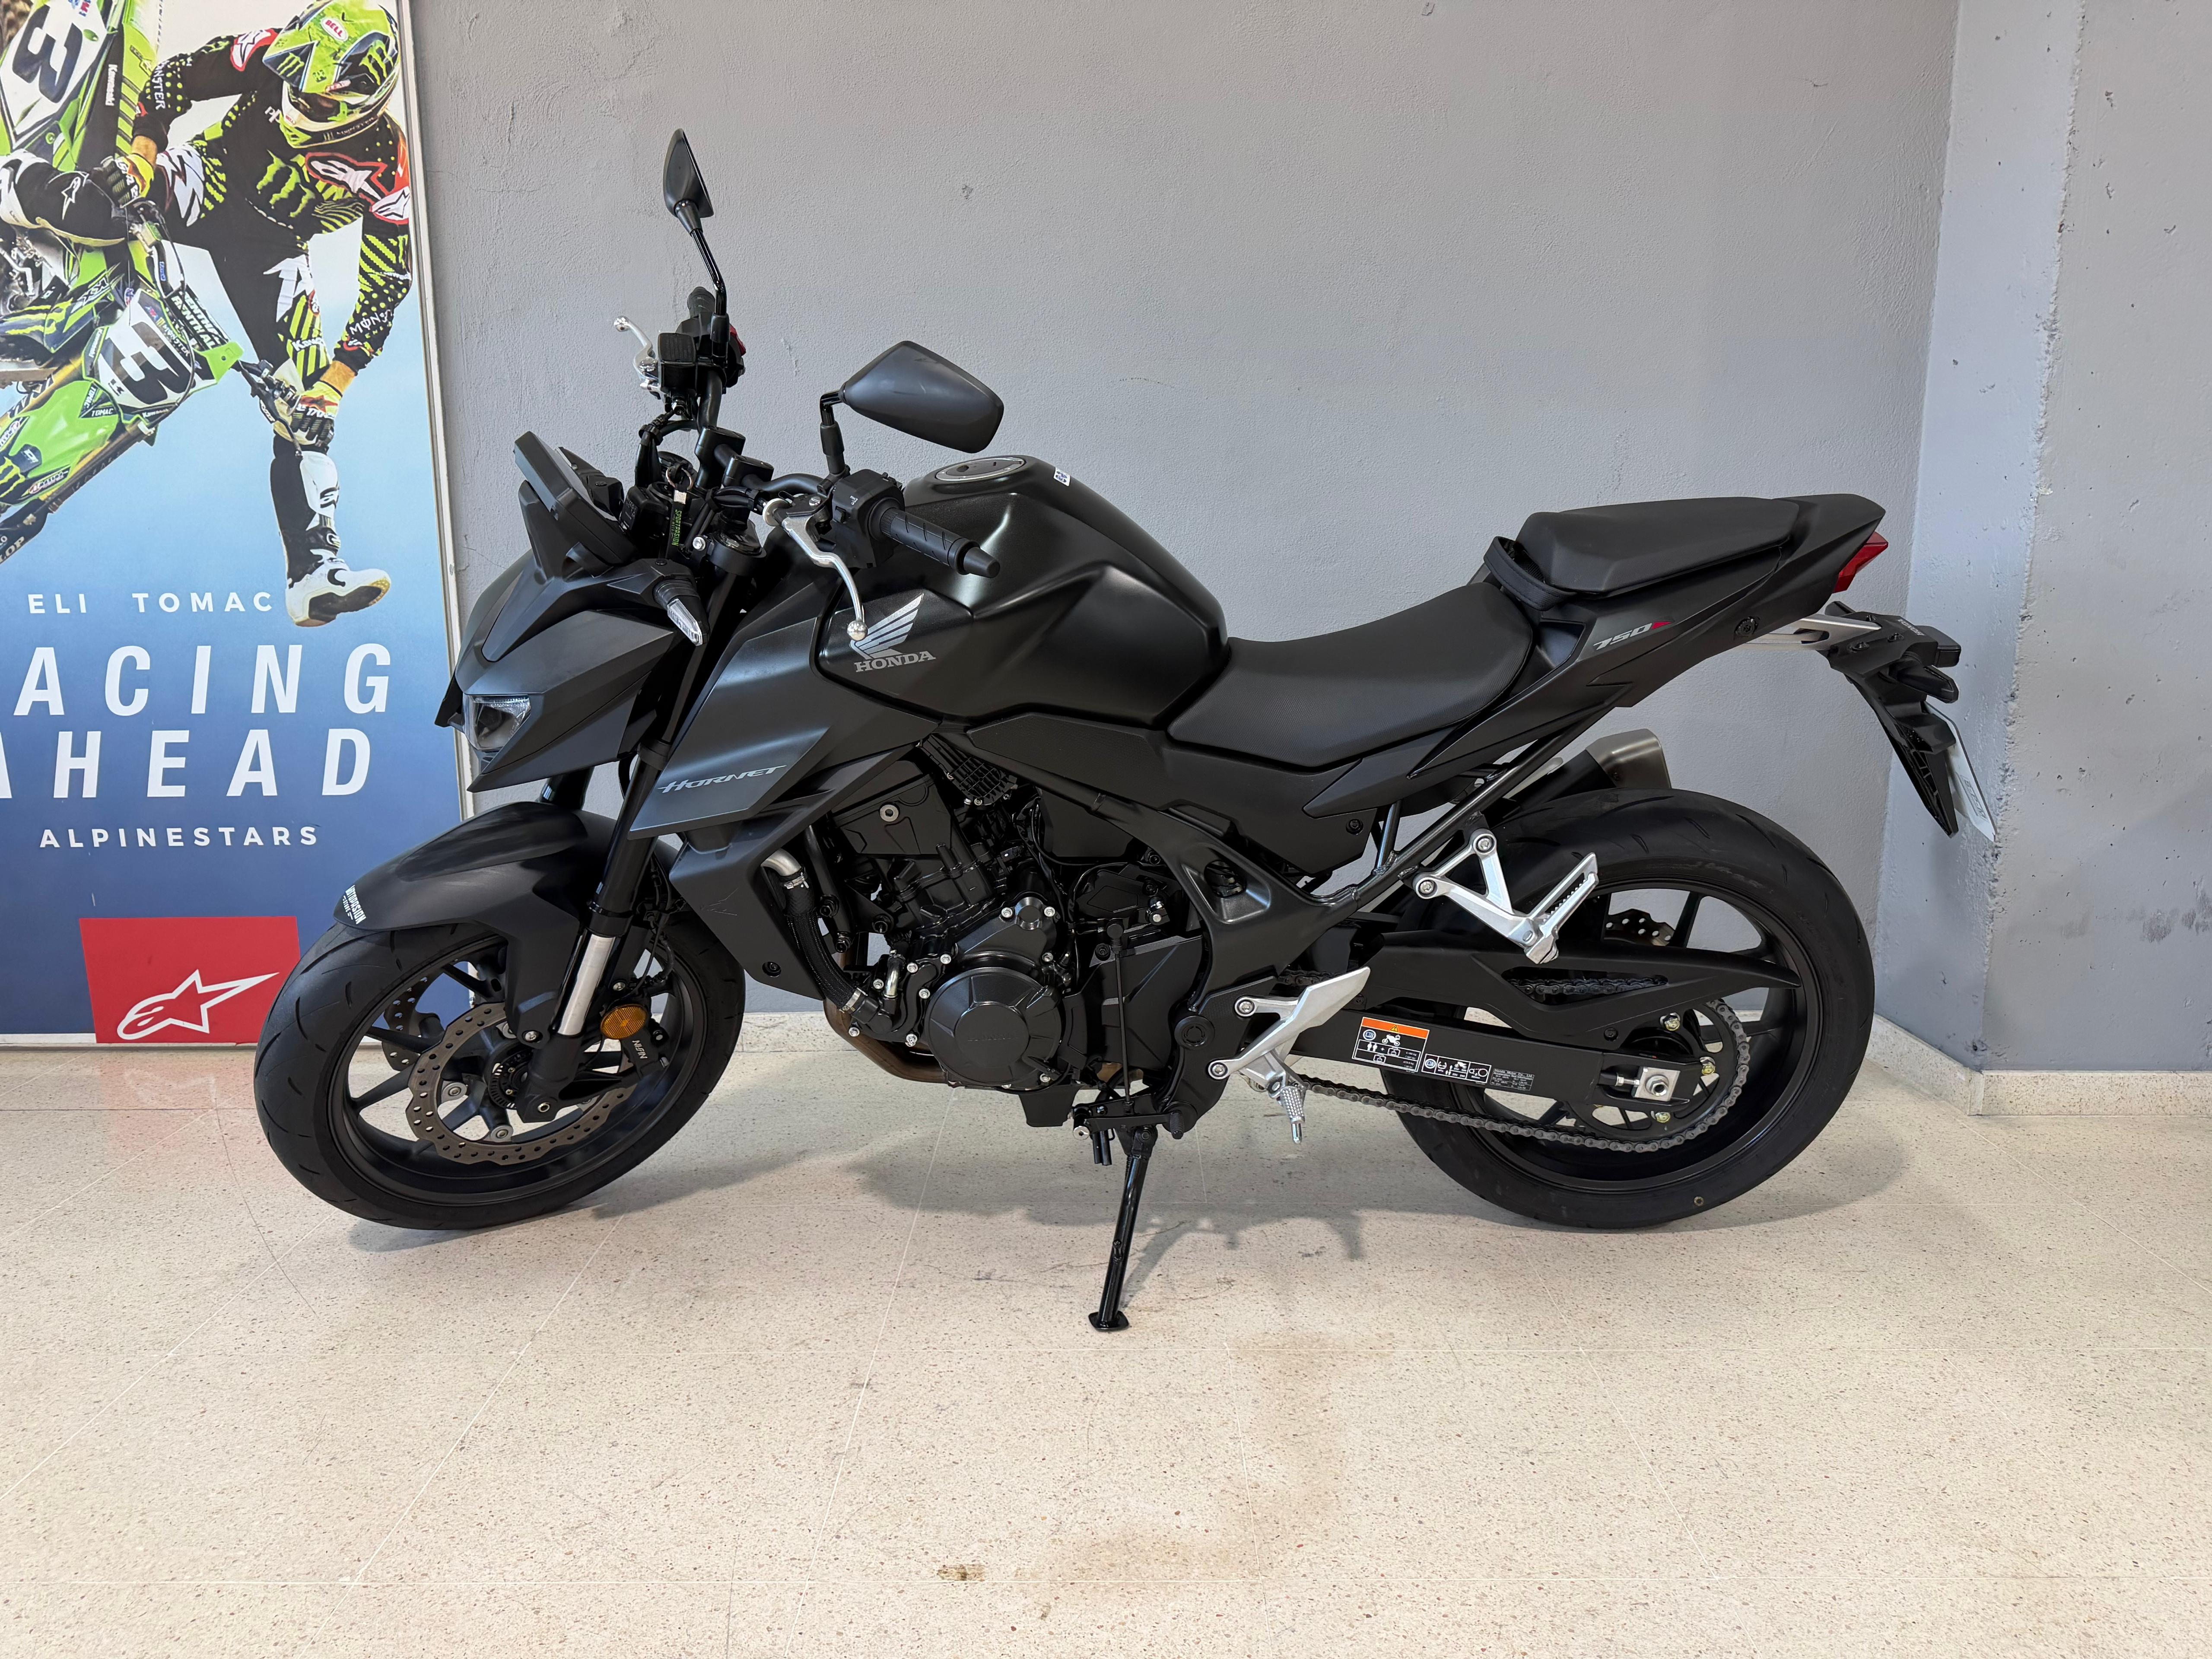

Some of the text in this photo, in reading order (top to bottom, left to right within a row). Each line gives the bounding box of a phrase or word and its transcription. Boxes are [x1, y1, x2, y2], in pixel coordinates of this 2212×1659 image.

[325, 19, 344, 38] BELL
[12, 4, 83, 103] 3
[105, 64, 118, 106] Kawasaki
[100, 321, 191, 405] 3
[91, 408, 114, 417] TOMAC
[671, 509, 682, 546] SPORTPASION
[28, 592, 272, 613] ELI TOMAC
[1593, 623, 1652, 650] 750
[854, 651, 936, 672] HONDA
[13, 643, 391, 716] ACING
[658, 765, 787, 793] HORNET
[40, 826, 317, 848] ALPINESTARS
[632, 1040, 648, 1059] NISSIN
